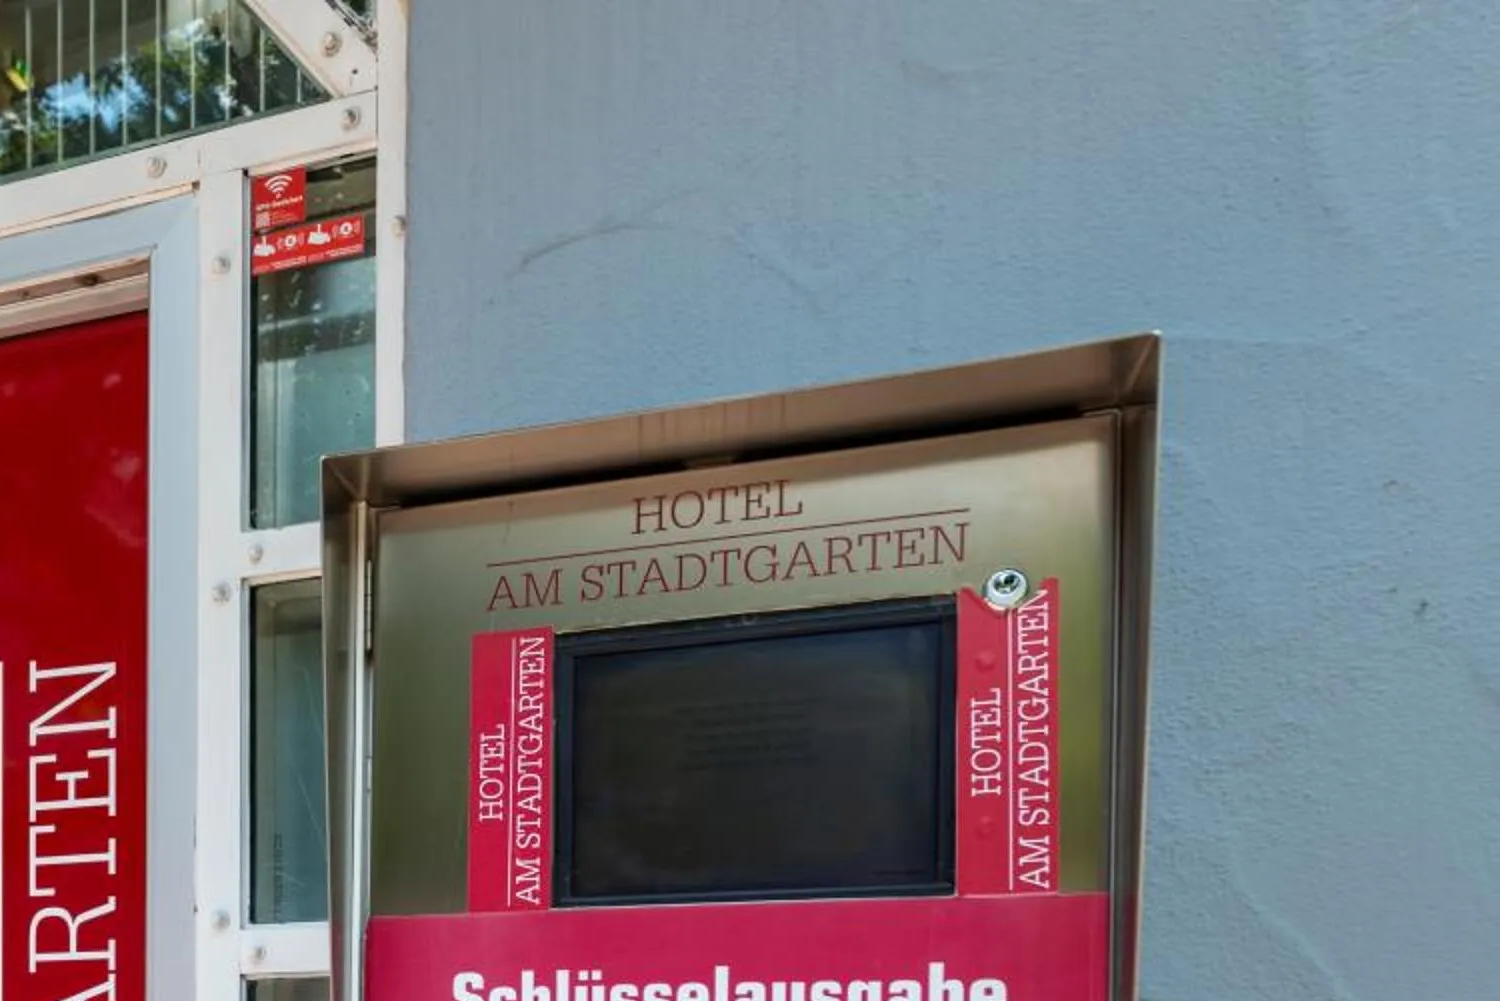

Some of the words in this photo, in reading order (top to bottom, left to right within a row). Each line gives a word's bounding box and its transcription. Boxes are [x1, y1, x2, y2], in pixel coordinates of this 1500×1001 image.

[631, 478, 803, 535] HOTEL
[486, 567, 563, 612] AM
[580, 521, 971, 602] STADTGARTEN
[515, 636, 545, 849] STADTGARTEN
[971, 687, 1002, 797] HOTEL
[1017, 589, 1050, 826] STADTGARTEN
[479, 723, 505, 822] HOTEL
[515, 856, 542, 905] AM
[1019, 835, 1050, 889] AM
